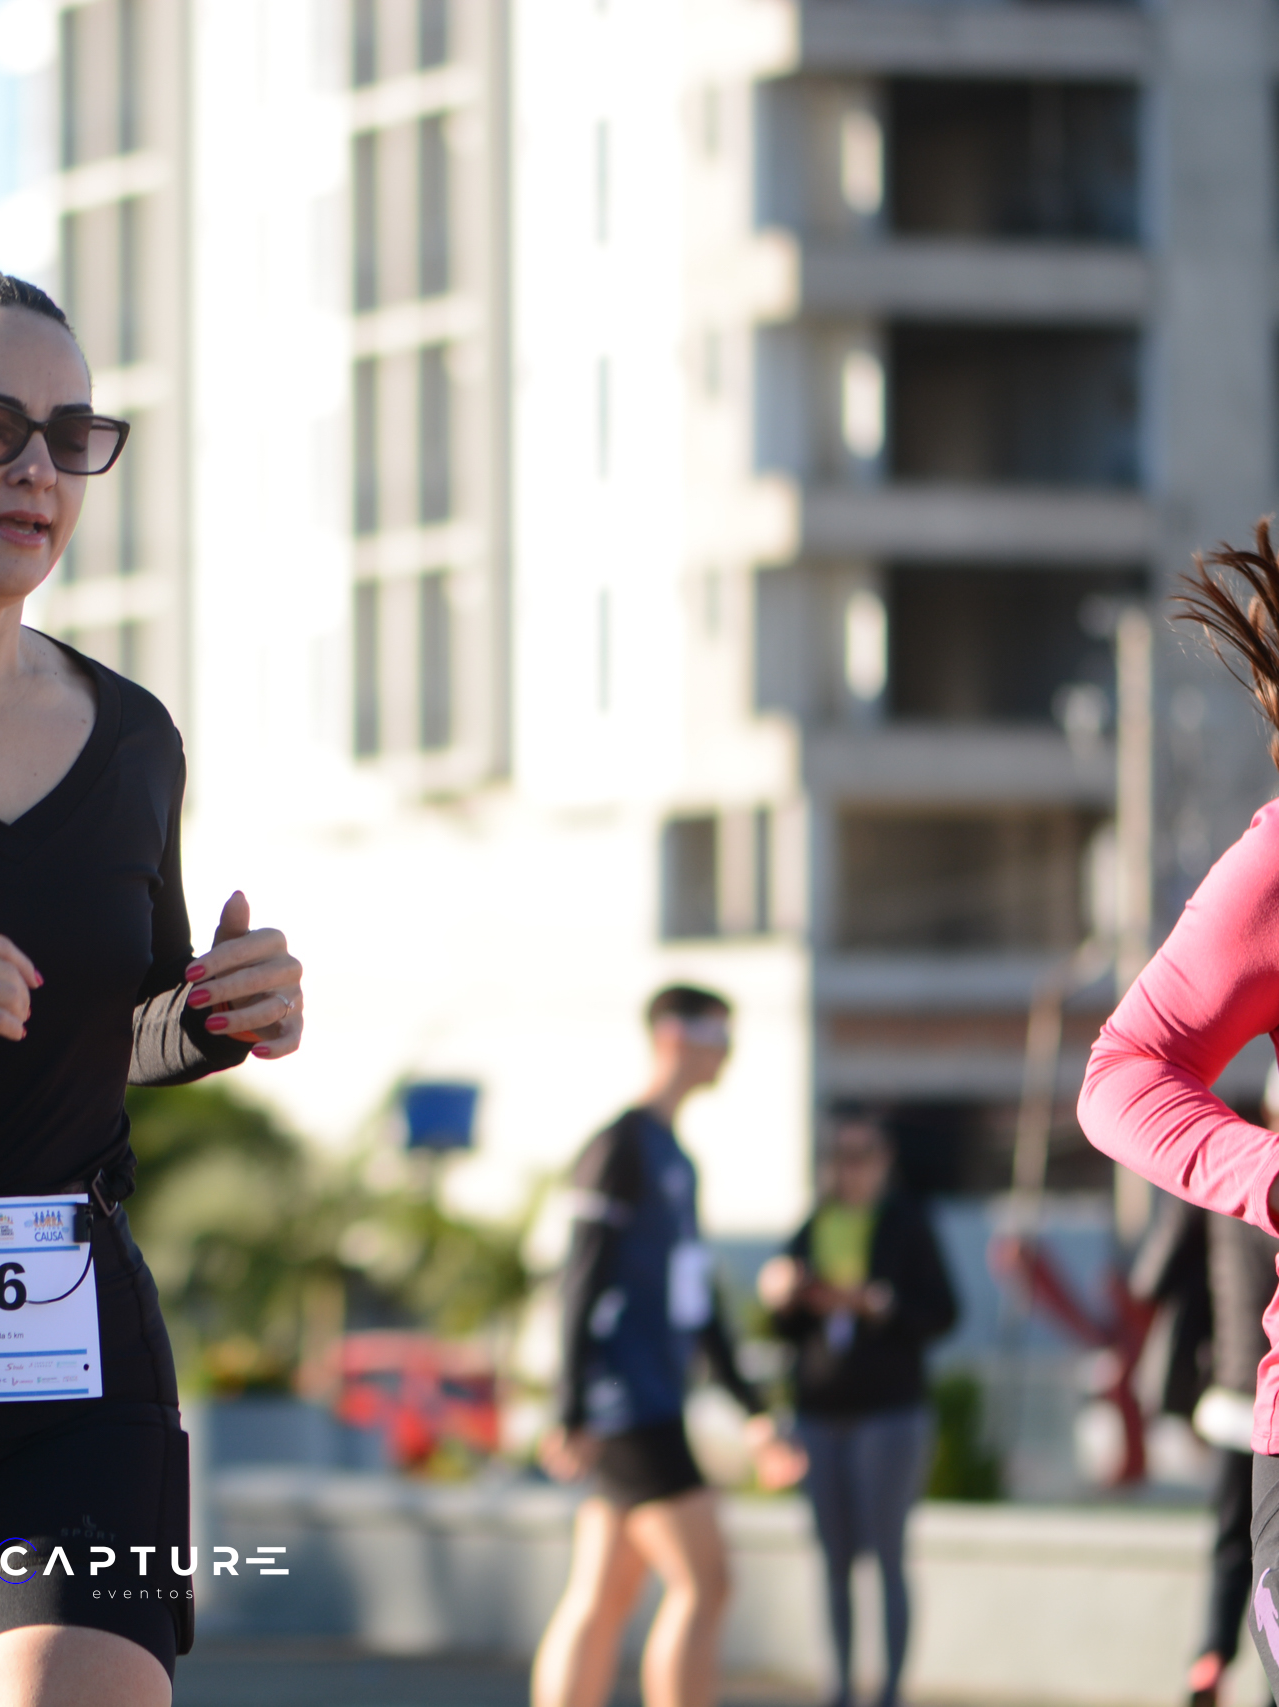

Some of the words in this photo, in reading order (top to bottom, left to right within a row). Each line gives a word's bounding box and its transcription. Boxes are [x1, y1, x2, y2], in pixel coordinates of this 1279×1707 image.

[34, 1231, 64, 1242] CAUSA
[13, 1331, 24, 1339] km
[60, 1527, 117, 1542] SPORT
